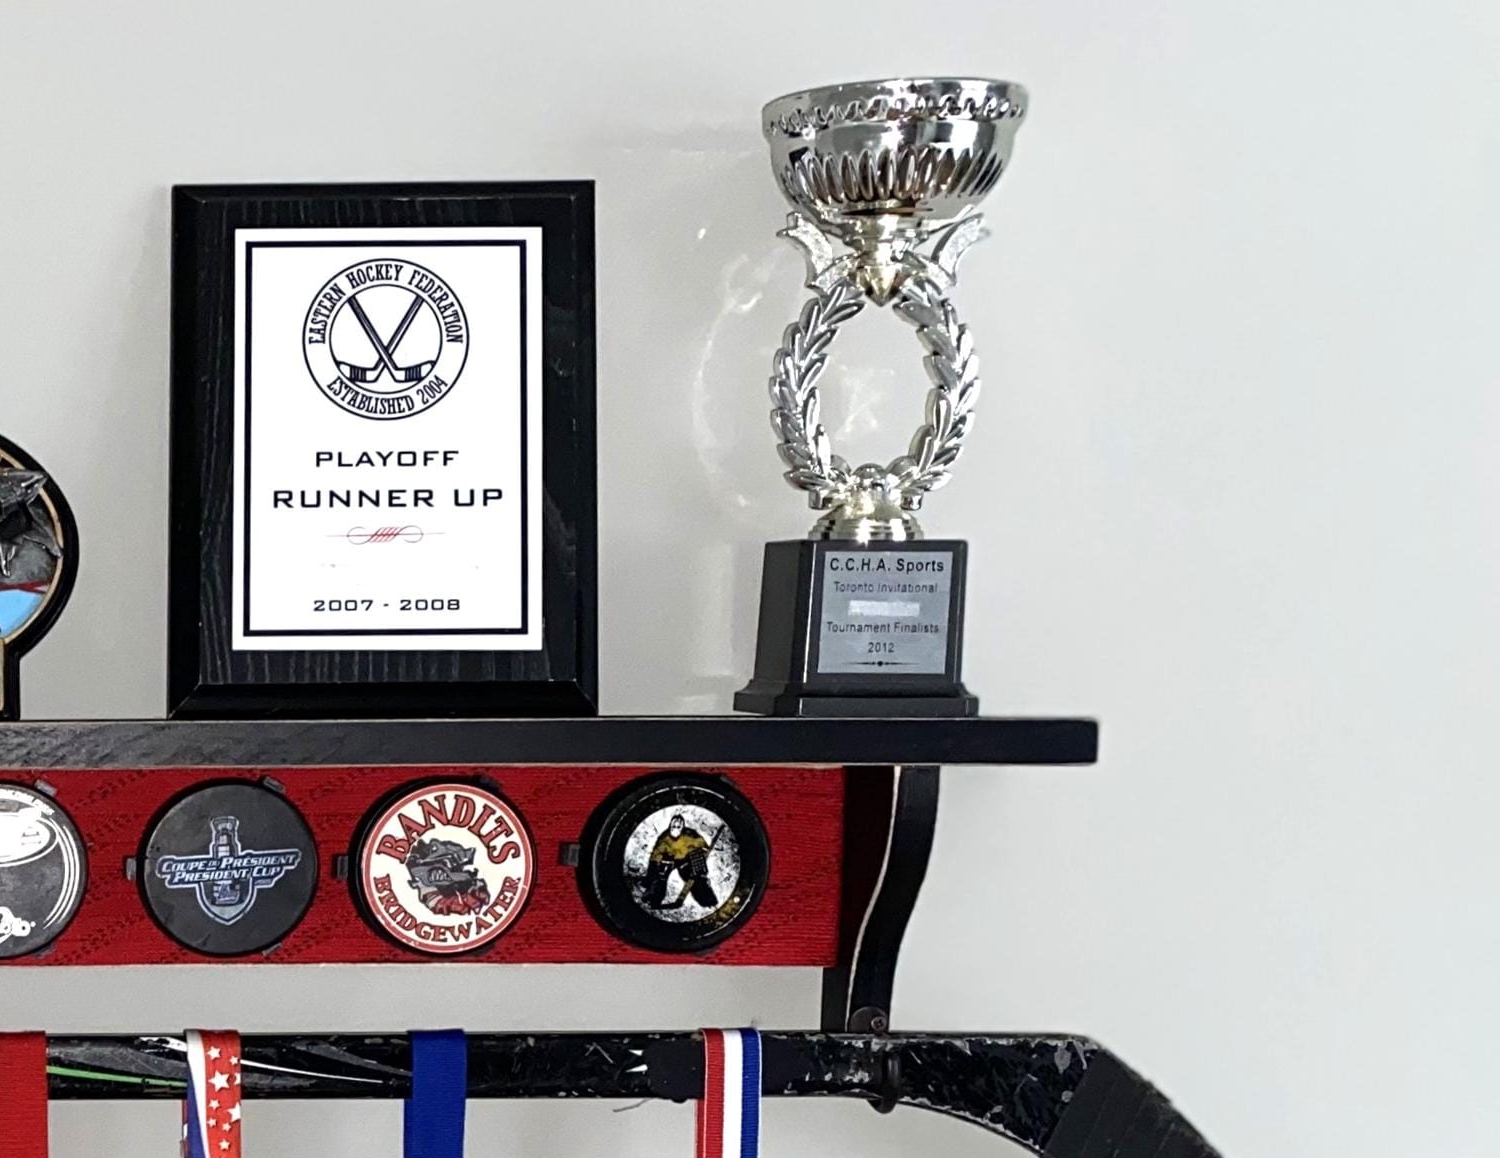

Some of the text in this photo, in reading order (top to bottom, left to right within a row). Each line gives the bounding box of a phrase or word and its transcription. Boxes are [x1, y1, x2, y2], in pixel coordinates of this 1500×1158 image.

[308, 263, 464, 344] EASTERN HOCKEY FEDERATION
[326, 374, 449, 415] ESTABLISHED 2004
[315, 450, 459, 467] PLAYOFF
[273, 488, 503, 508] RUNNER UP
[830, 558, 945, 574] C.C.H.A. Sports
[833, 581, 938, 593] Toronto Invitational
[313, 599, 374, 612] 2007
[399, 599, 461, 611] 2008
[827, 621, 939, 634] Tournament Finalists
[867, 642, 895, 653] 2012
[376, 793, 521, 865] BANDITS
[161, 859, 208, 873] COUPE
[172, 869, 250, 883] PRESIDENT
[252, 865, 282, 878] CUP
[373, 873, 522, 942] BRIDGEWATER
